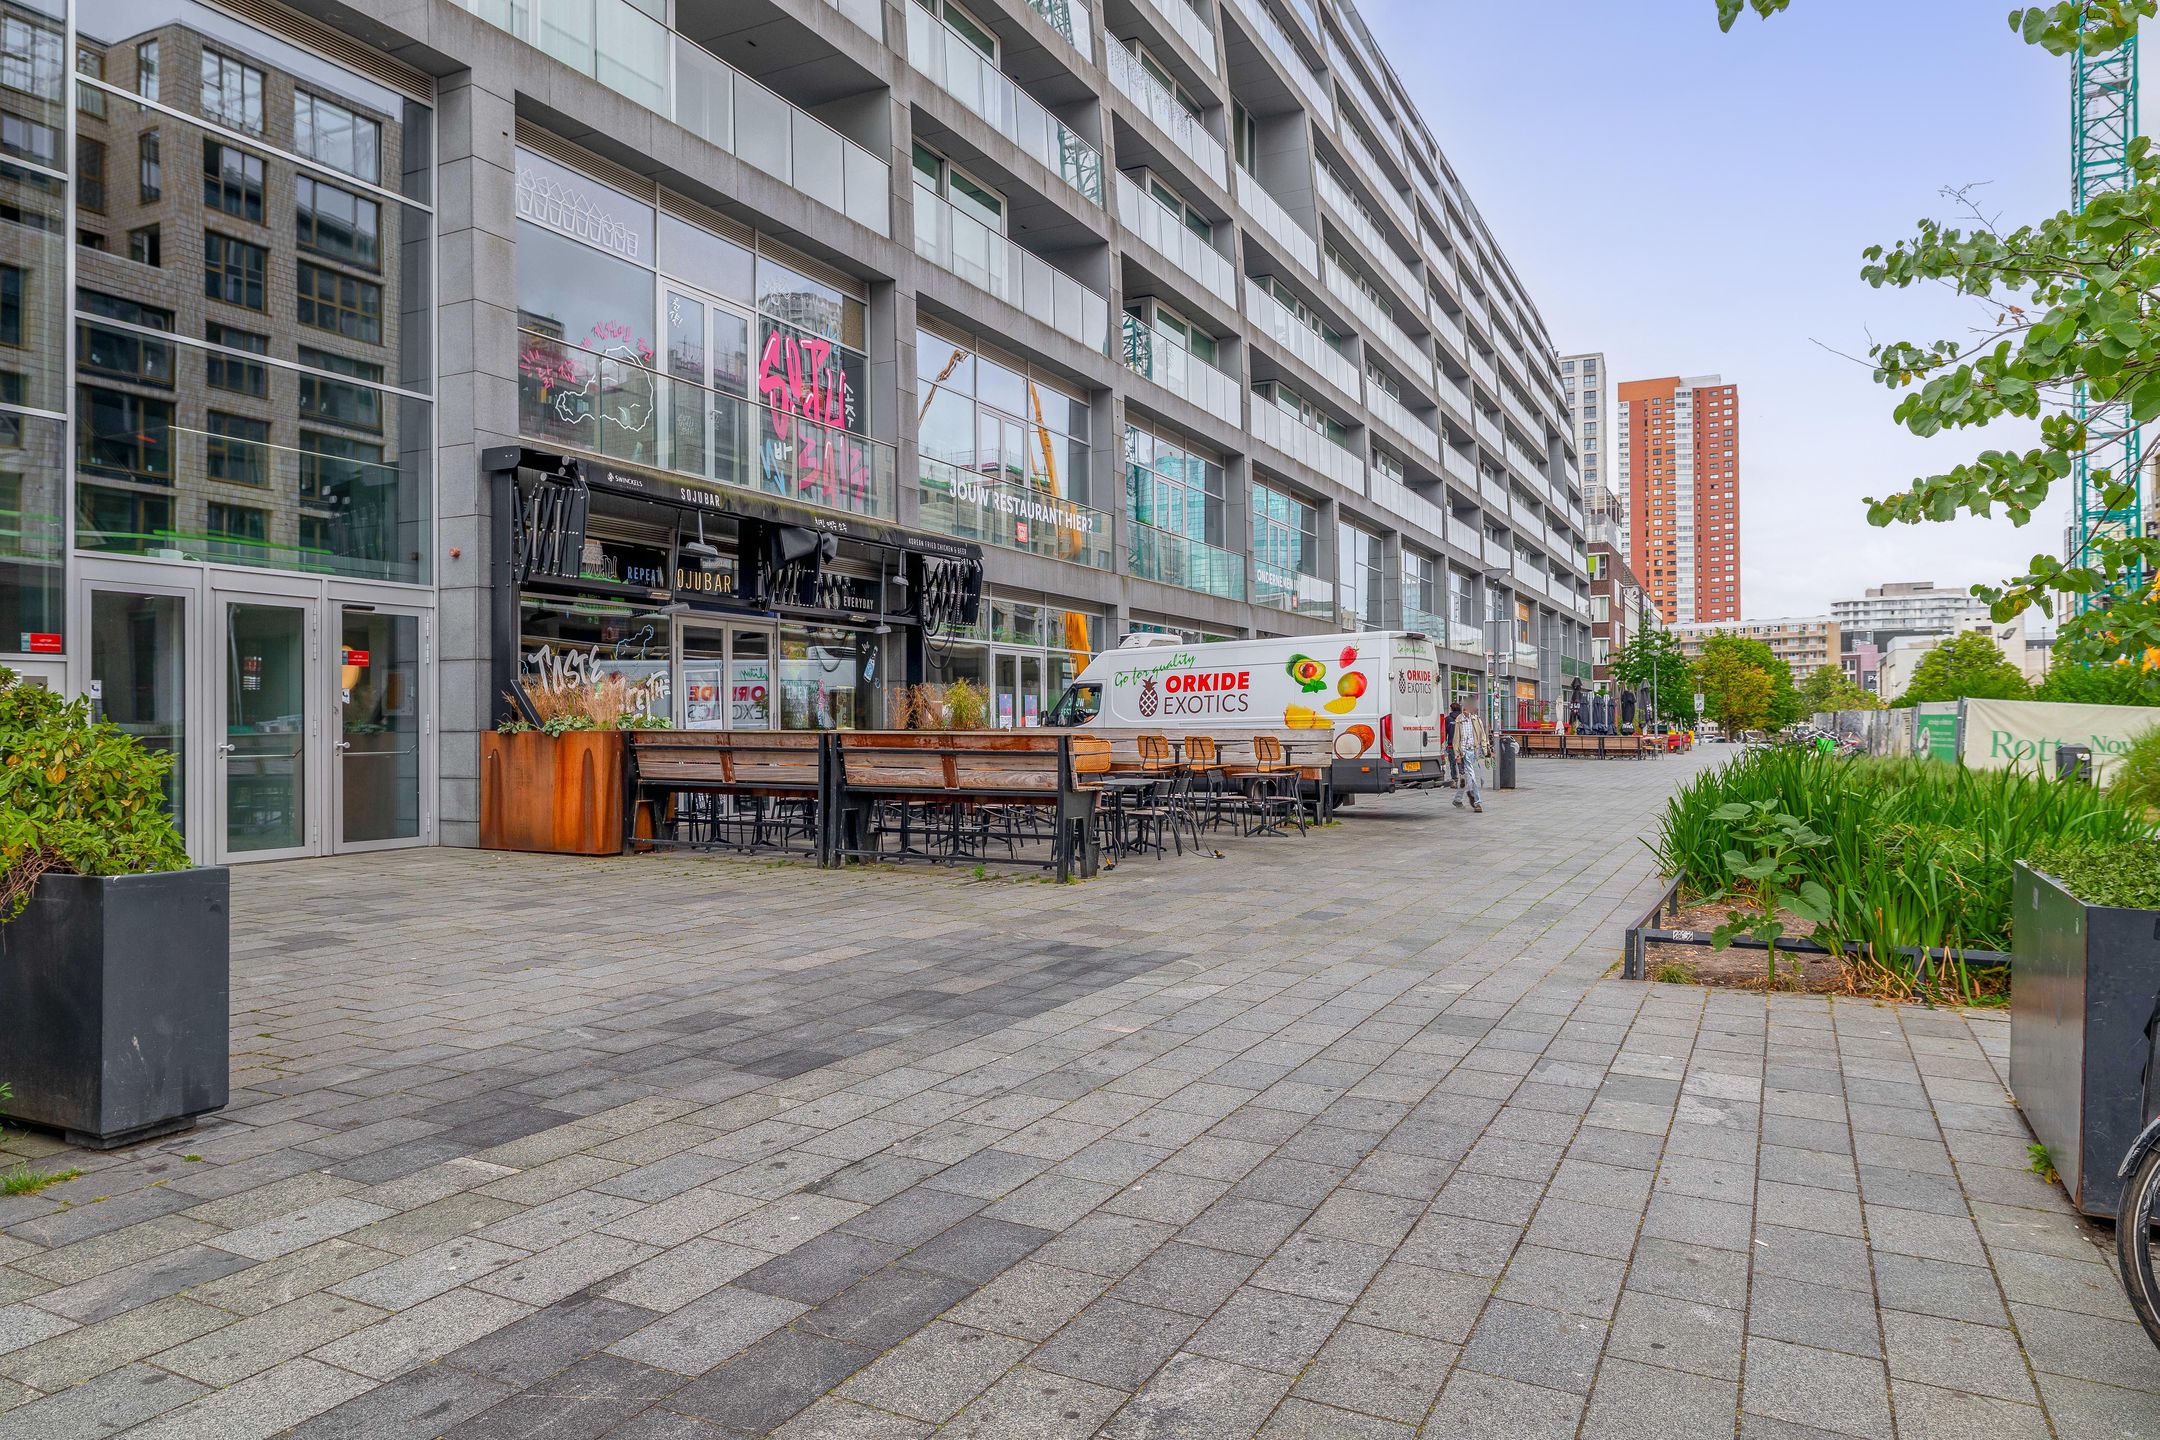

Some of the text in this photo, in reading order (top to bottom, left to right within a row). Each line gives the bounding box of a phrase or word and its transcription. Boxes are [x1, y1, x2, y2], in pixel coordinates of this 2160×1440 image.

[615, 474, 643, 487] SWINCKELS
[950, 479, 1093, 534] JOUW RESTAURANT HIER?
[908, 537, 925, 547] KOREAN
[924, 540, 937, 550] FRIED
[937, 543, 953, 553] CHICKEN
[677, 568, 732, 594] OJUBAR
[843, 596, 874, 610] EVERYDAY
[1114, 652, 1197, 688] Go for quality
[1407, 669, 1431, 681] ORKIDE
[1165, 671, 1250, 693] ORKIDE
[1407, 682, 1431, 694] EXOTICS
[1163, 693, 1249, 714] EXOTICS
